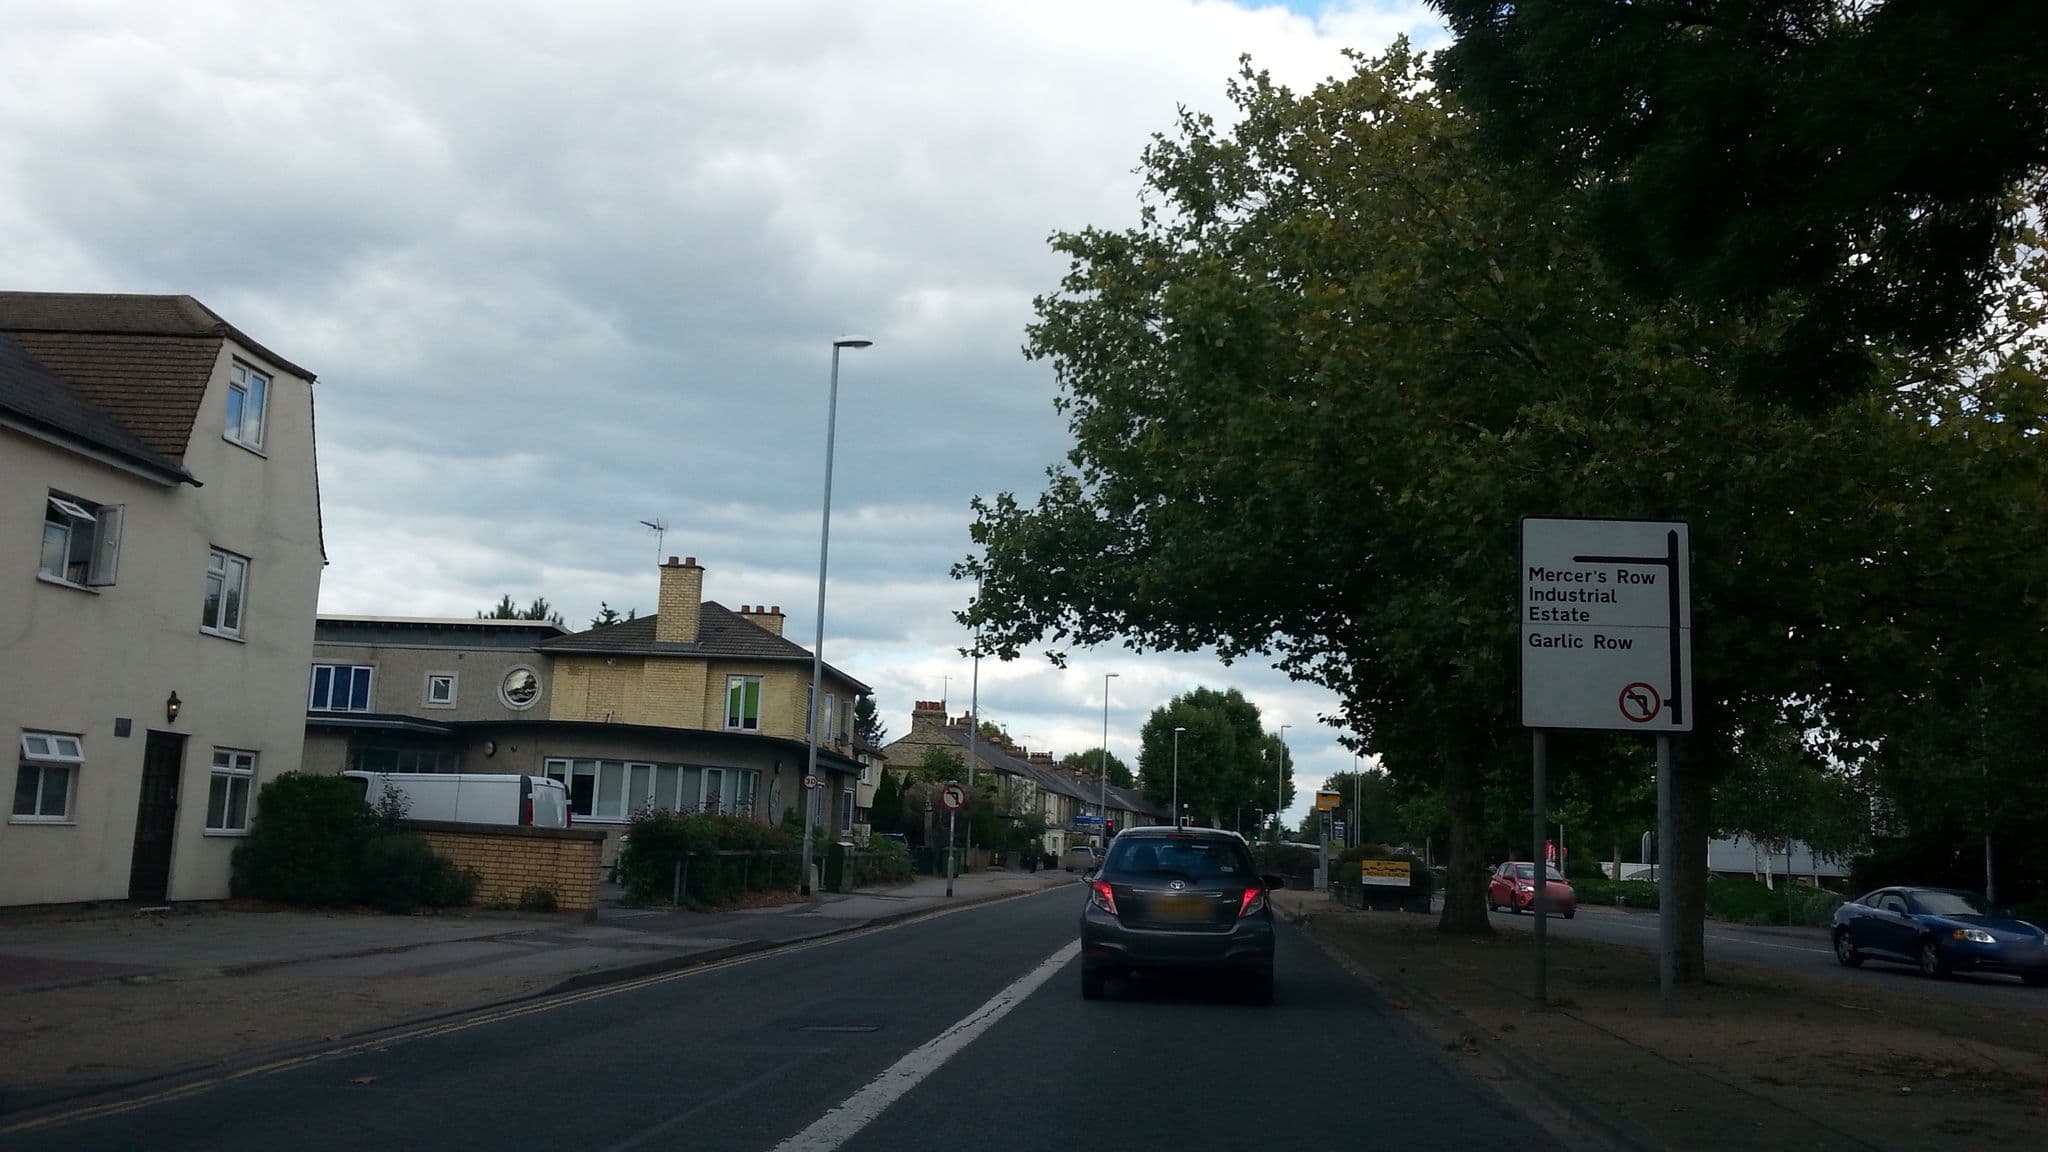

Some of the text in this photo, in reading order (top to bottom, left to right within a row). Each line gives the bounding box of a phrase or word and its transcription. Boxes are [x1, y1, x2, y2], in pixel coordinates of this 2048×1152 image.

[1529, 567, 1656, 585] Mercer's Row
[1529, 586, 1617, 604] Industrial
[1529, 606, 1590, 622] Estate
[1528, 633, 1633, 650] Garlic Row
